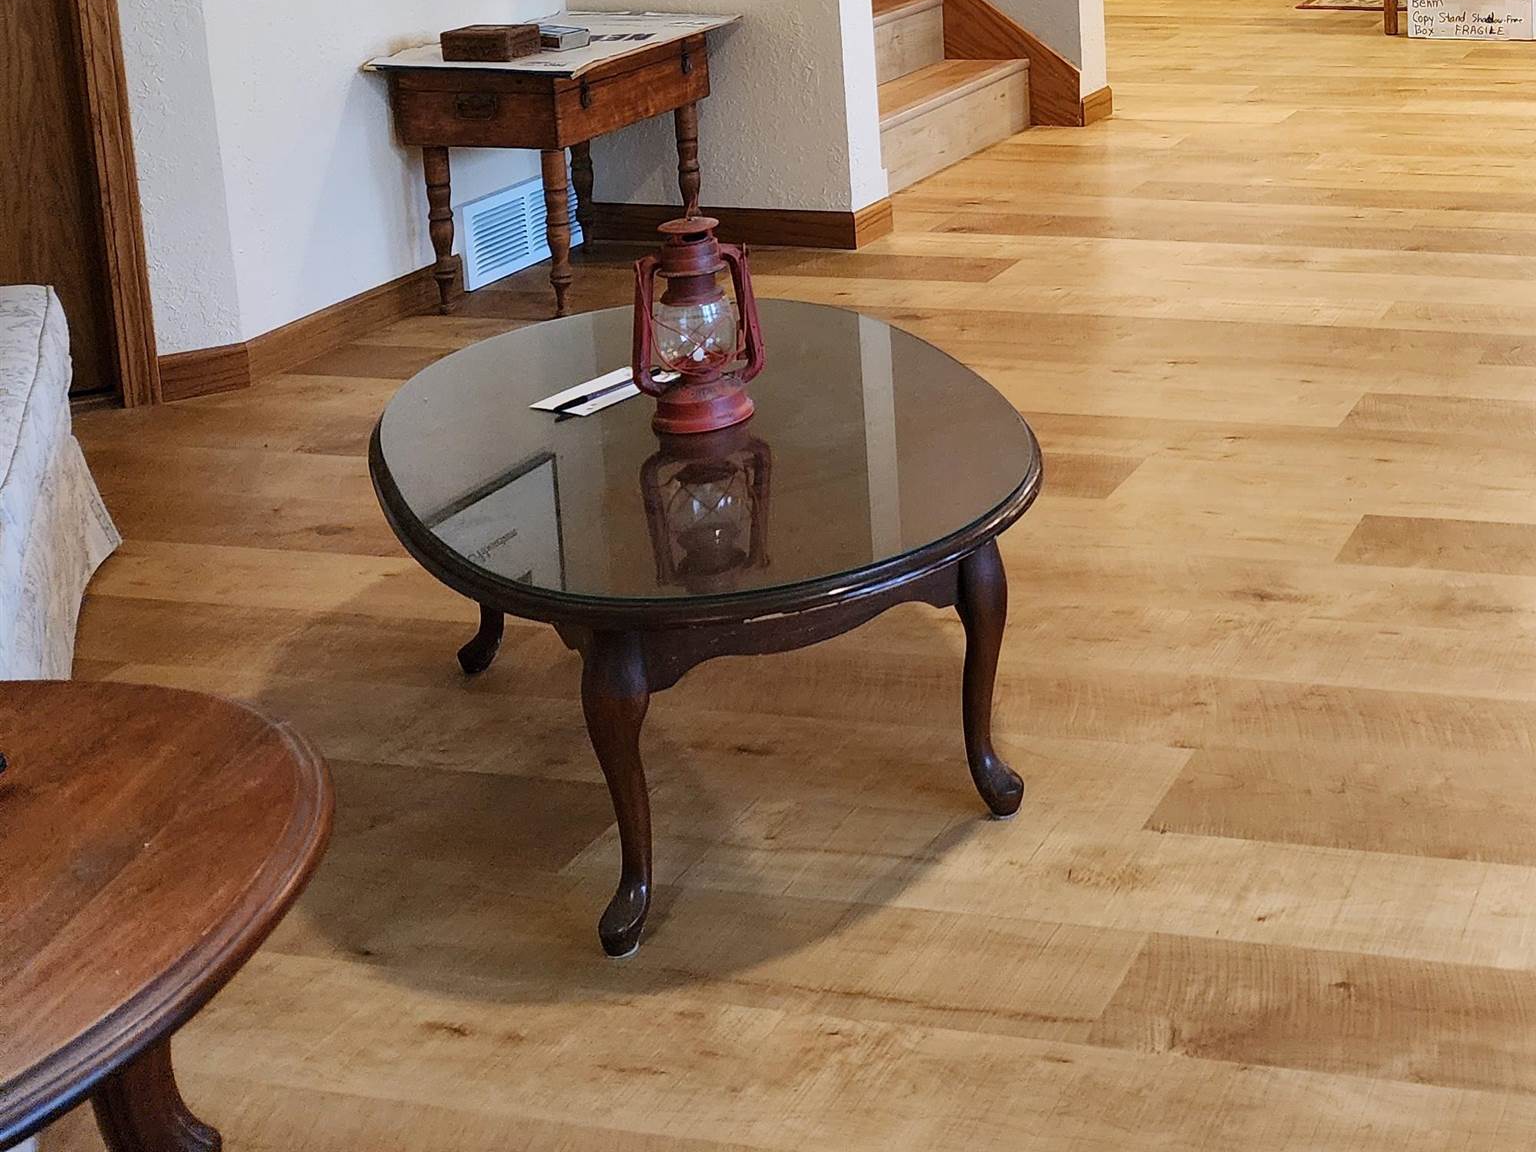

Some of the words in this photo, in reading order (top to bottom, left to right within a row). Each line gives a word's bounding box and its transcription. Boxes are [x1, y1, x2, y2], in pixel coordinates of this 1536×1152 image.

[1412, 10, 1434, 26] Copy
[1439, 11, 1466, 23] Stand
[1415, 26, 1434, 36] Box
[1455, 25, 1504, 36] FRAGILE
